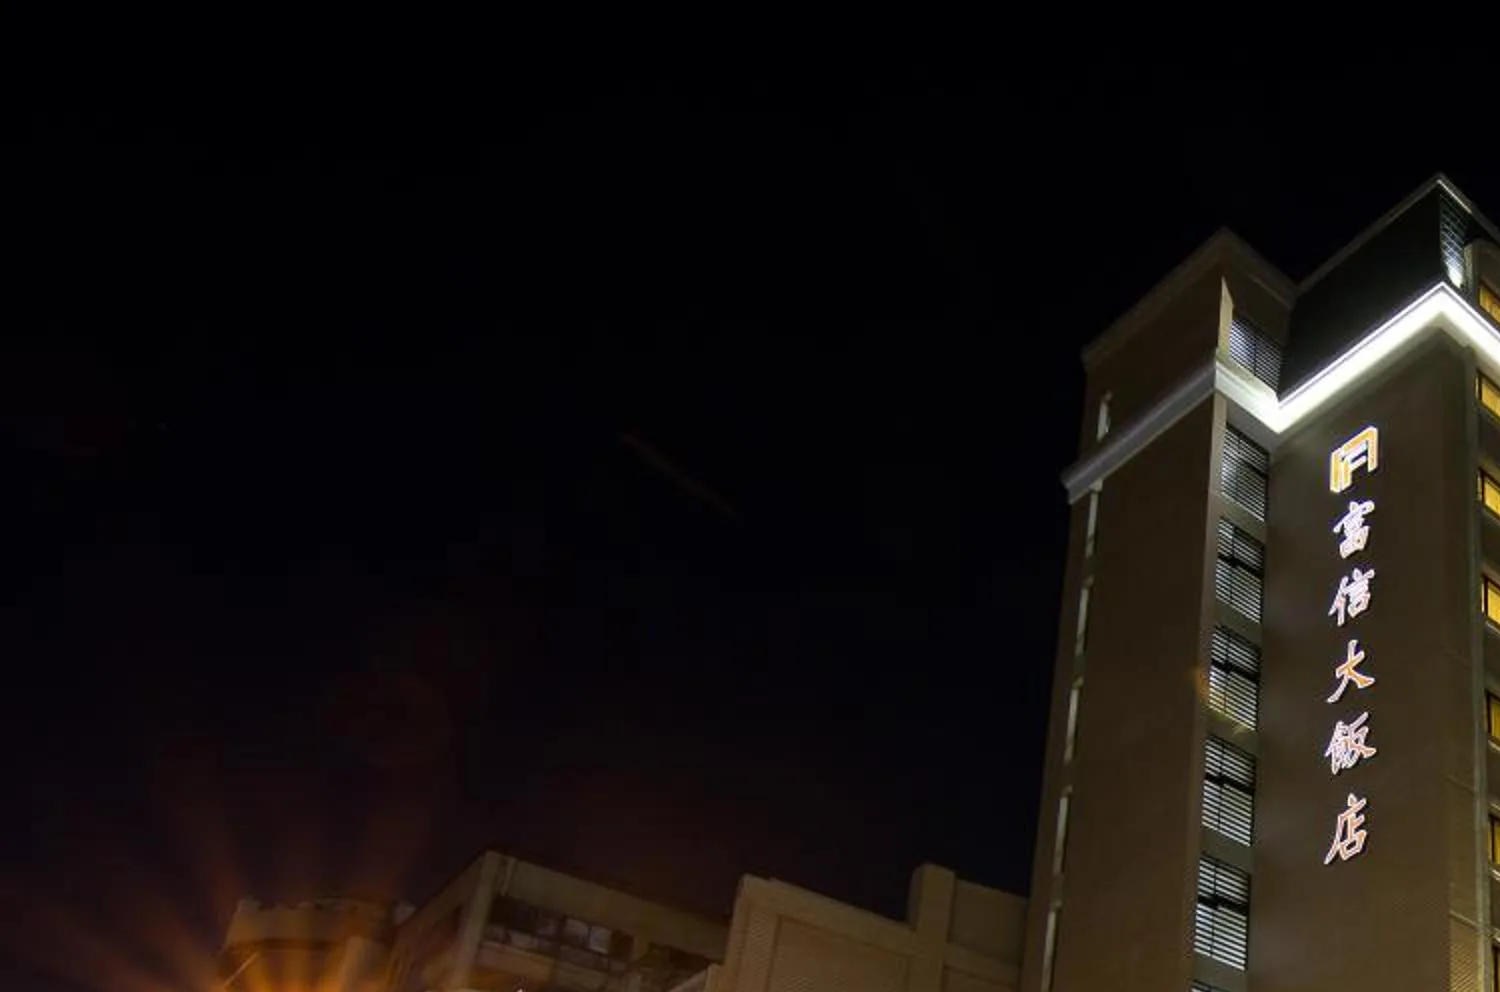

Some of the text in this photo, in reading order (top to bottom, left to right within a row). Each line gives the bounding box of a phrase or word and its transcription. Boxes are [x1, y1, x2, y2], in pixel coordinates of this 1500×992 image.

[1324, 500, 1377, 866] 富信大飯店
